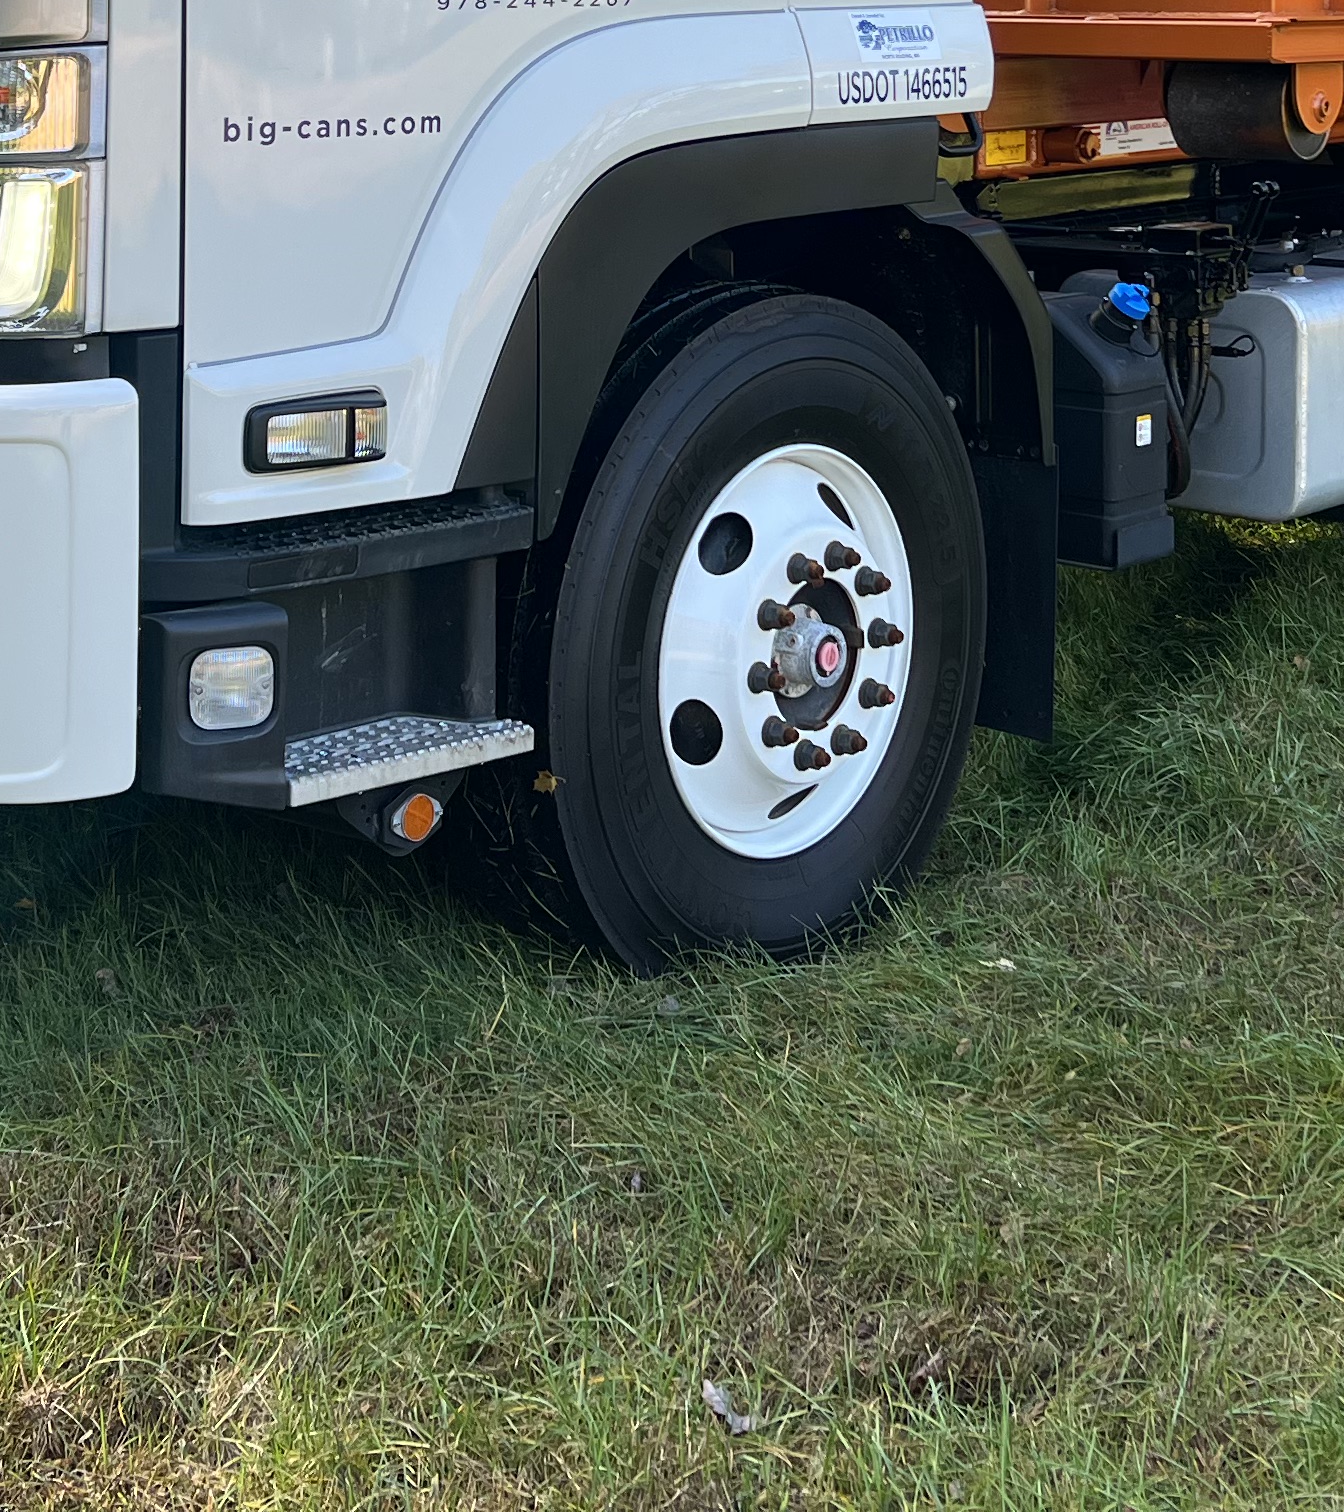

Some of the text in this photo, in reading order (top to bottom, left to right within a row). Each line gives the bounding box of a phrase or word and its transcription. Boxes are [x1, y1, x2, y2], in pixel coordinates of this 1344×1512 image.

[877, 25, 935, 45] PETRILLO
[838, 66, 967, 105] USDOT 1466515
[223, 114, 442, 146] big-cans.com
